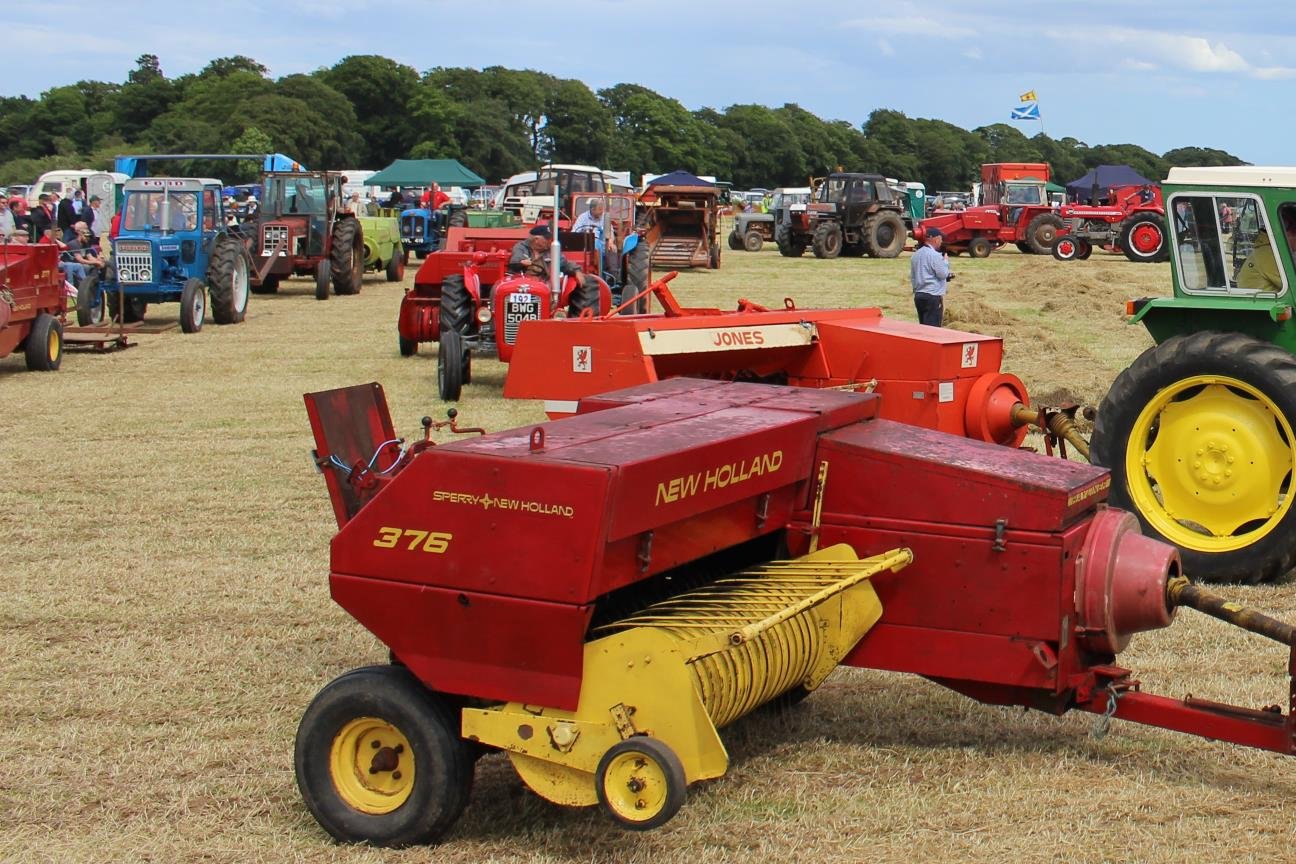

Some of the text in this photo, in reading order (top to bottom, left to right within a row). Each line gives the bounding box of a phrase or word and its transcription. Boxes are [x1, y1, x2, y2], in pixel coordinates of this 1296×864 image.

[511, 303, 534, 313] BWG
[714, 331, 765, 346] JONES
[655, 450, 783, 506] NEW HOLLAND
[433, 490, 574, 517] SPERRY NEW HOLLAND
[373, 526, 453, 554] 376
